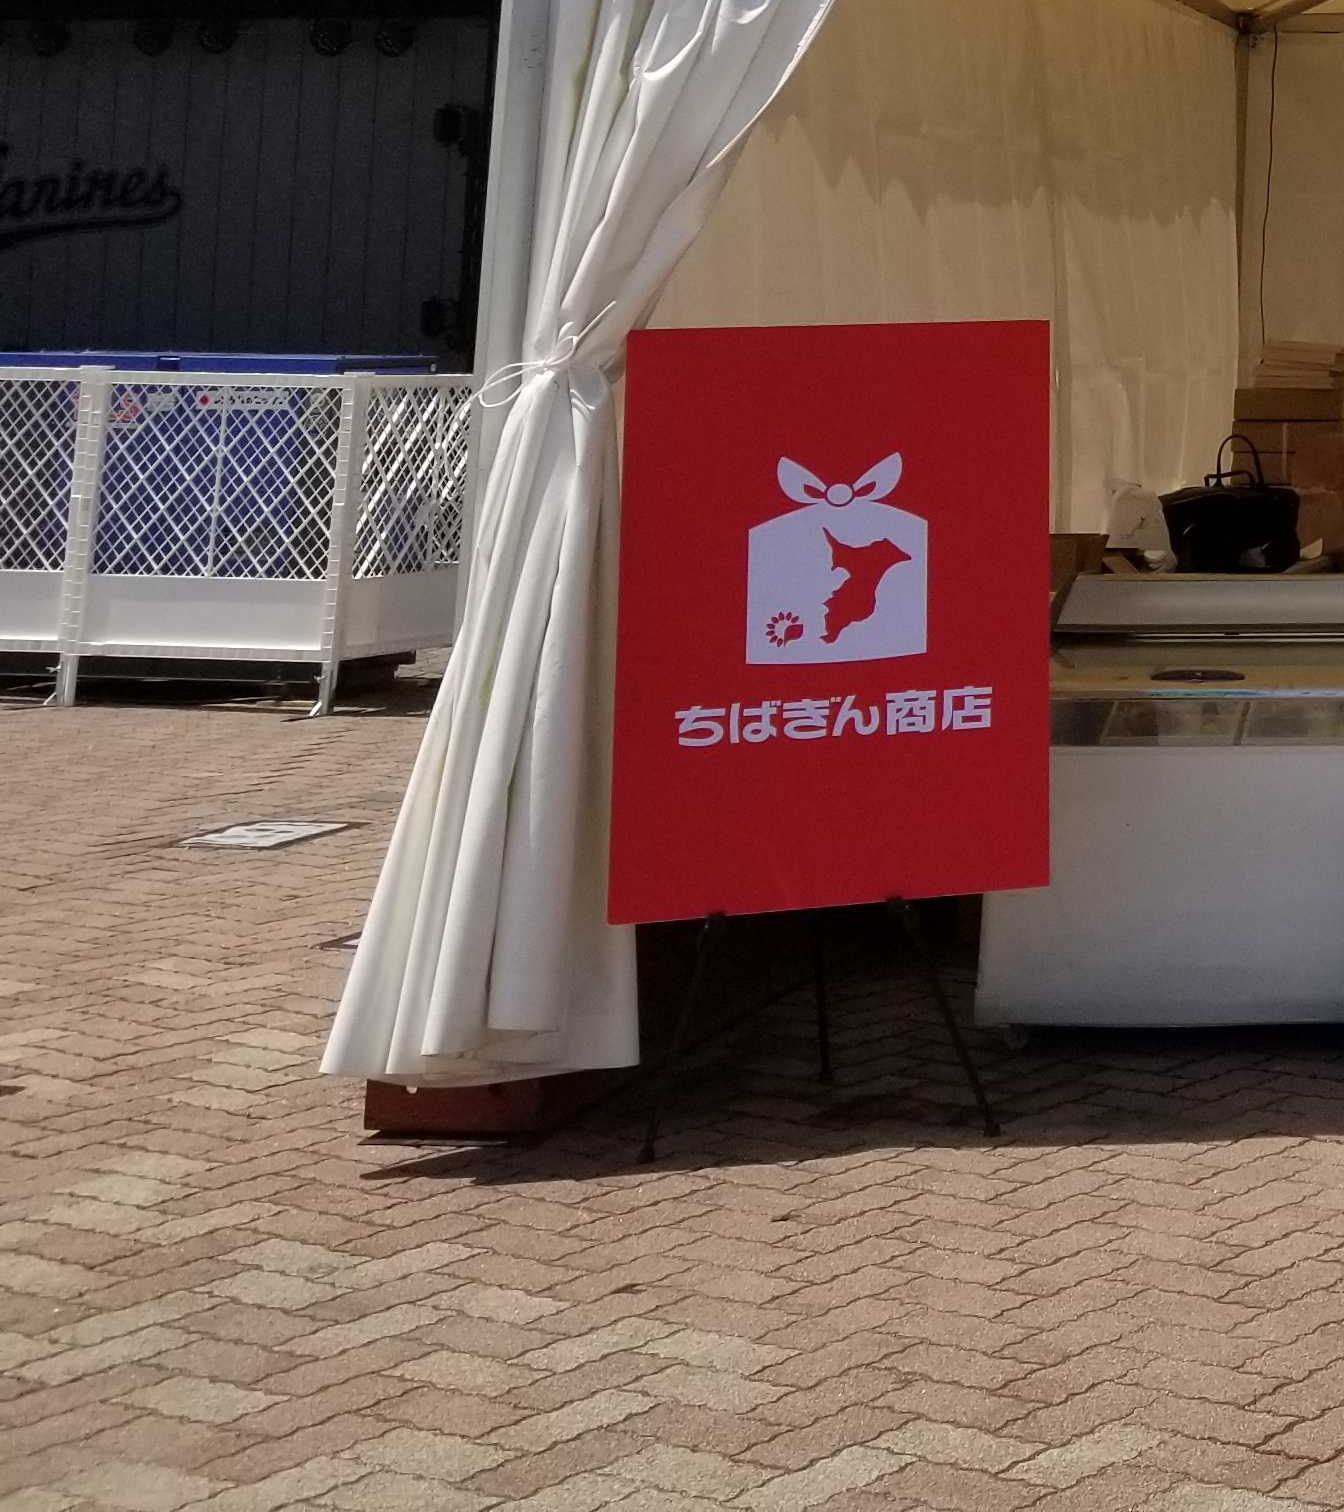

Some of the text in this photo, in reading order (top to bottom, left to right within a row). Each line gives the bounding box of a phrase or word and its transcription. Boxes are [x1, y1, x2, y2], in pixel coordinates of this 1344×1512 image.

[675, 686, 992, 747] ちばぎん商店
